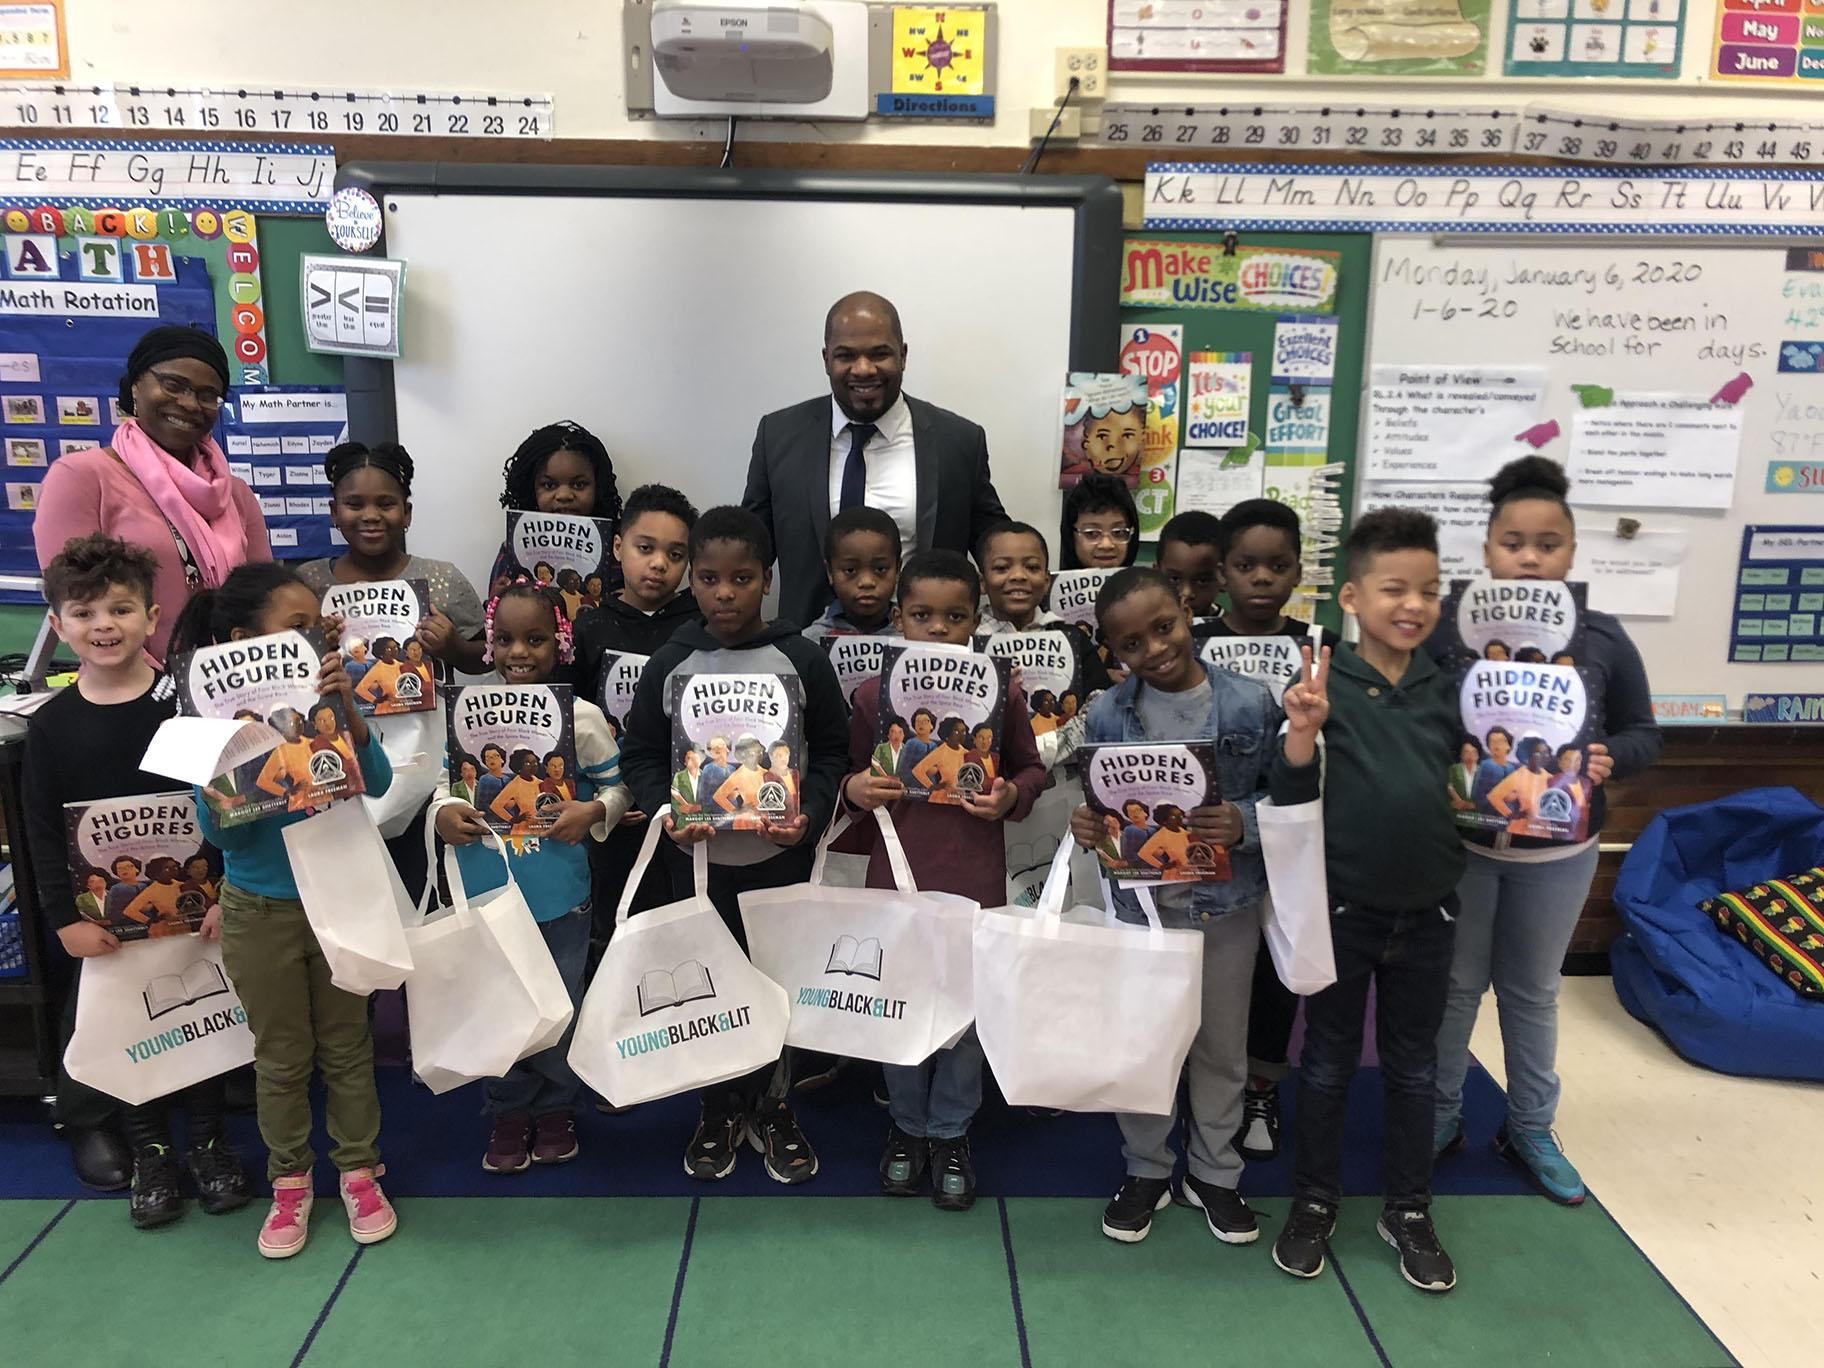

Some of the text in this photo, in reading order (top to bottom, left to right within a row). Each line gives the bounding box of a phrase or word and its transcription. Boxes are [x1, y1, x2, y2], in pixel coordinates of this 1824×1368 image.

[720, 18, 748, 27] EPSON
[935, 12, 945, 22] N
[1742, 20, 1778, 41] May
[902, 47, 915, 58] W
[1735, 52, 1779, 70] June
[935, 81, 942, 91] S
[893, 98, 976, 112] Directions
[17, 104, 539, 135] 10 11 12 13 14 15 16 17 18 19 20 21 22 23 24
[1108, 124, 1811, 160] 25 26 27 28 29 30 31 32 33 34 35 36 37 38 39 40 41 42 43 44 45
[16, 153, 326, 198] Ee Ff Gg Hh Ii Jj
[1152, 176, 1195, 203] Kk
[1216, 177, 1246, 204] Ll
[1263, 178, 1315, 205] Mm
[1335, 178, 1376, 206] Nn
[1394, 178, 1428, 206] Oo
[1445, 178, 1480, 217] Pp
[1498, 179, 1537, 219] Qq
[1555, 180, 1592, 208] Rr
[1610, 181, 1642, 208] Ss
[1661, 181, 1688, 209] Tt
[1705, 182, 1742, 209] Uu
[1763, 182, 1792, 210] Vv
[334, 200, 374, 219] Believe
[334, 224, 373, 241] YOURSELF
[1123, 248, 1211, 292] Make
[1242, 262, 1330, 293] CHOICES!
[1383, 257, 1498, 296] Monday,
[1506, 260, 1596, 294] January
[1632, 261, 1703, 284] 2020
[1173, 276, 1237, 303] Wise
[0, 289, 156, 311] Math Rotation
[1413, 298, 1519, 321] 1-6-20
[1553, 302, 1728, 332] We have been in
[1136, 330, 1146, 342] 1
[1278, 333, 1332, 349] Excellent
[1276, 346, 1331, 365] CHOICES
[1623, 335, 1662, 356] for
[1697, 339, 1768, 367] days.
[1122, 350, 1178, 377] STOP
[1191, 372, 1223, 397] It's
[1399, 373, 1482, 386] Point of View
[242, 399, 321, 410] My Math Partner
[1203, 395, 1248, 419] your
[1273, 402, 1322, 423] Great
[1189, 420, 1246, 439] CHOICE!
[1270, 423, 1326, 442] EFFORT
[1135, 489, 1169, 515] CT
[523, 520, 591, 539] HIDDEN
[522, 535, 595, 554] FIGURES
[1059, 575, 1107, 595] HIDD
[331, 587, 406, 608] HIDDEN
[1059, 592, 1100, 610] FIGU
[1473, 587, 1562, 607] HIDDEN
[1471, 606, 1565, 626] FIGURES
[837, 641, 882, 660] HIDD
[993, 638, 1062, 656] HIDDEN
[1210, 643, 1290, 661] HIDDEN
[200, 642, 300, 678] HIDDEN
[837, 658, 880, 677] FIGU
[905, 657, 987, 680] HIDDEN
[203, 662, 311, 700] FIGURES
[693, 680, 776, 700] HIDDEN
[901, 675, 989, 699] FIGURES
[1477, 670, 1570, 695] HIDDEN
[465, 692, 548, 712] HIDDEN
[692, 698, 780, 719] FIGURES
[1473, 690, 1574, 716] FIGURES
[464, 710, 553, 730] FIGURES
[1100, 754, 1188, 772] HIDDEN
[1101, 770, 1195, 788] FIGURES
[90, 805, 189, 829] HIDDEN
[90, 821, 195, 847] FIGURES
[124, 1006, 247, 1064] YOUNGBLACK&
